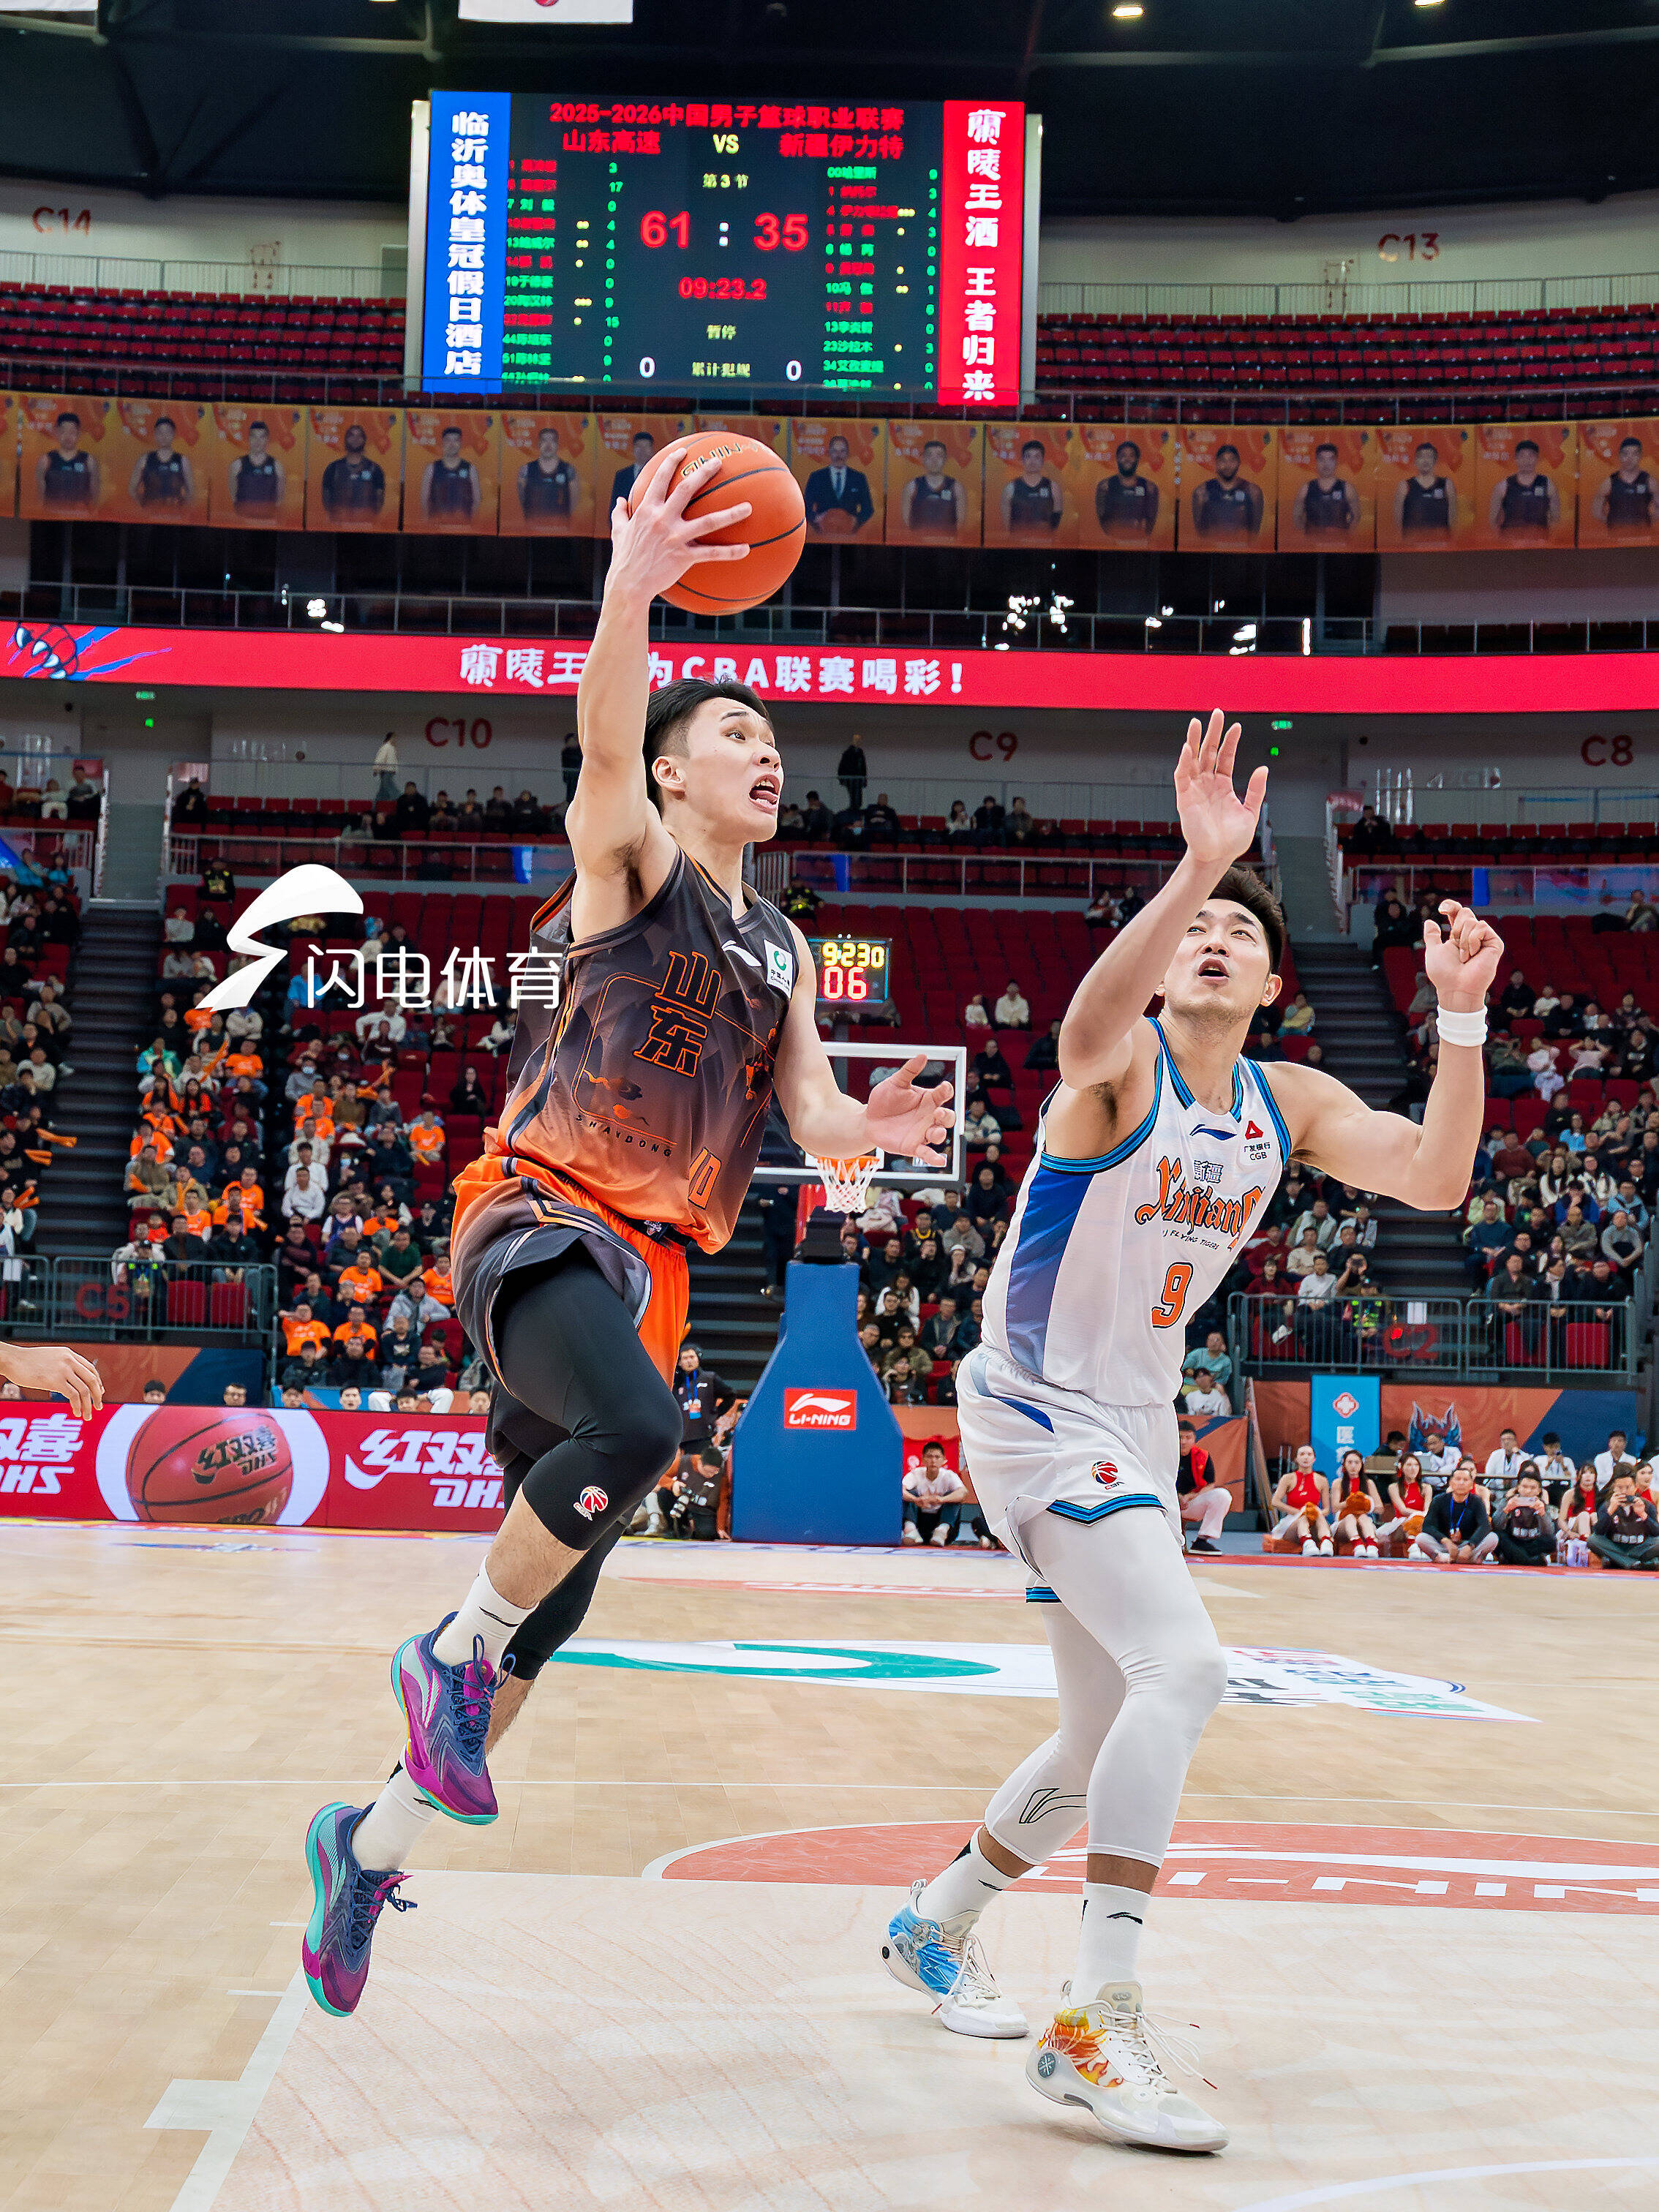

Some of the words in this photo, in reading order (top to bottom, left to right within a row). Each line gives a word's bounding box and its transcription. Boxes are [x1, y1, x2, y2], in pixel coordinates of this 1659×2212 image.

[549, 102, 905, 130] 2025-2026中国男子篮球职业联赛
[562, 129, 661, 155] 山东高速
[712, 134, 740, 154] VS
[780, 133, 904, 159] 新疆伊力特
[609, 162, 618, 174] 3
[609, 181, 624, 193] 17
[721, 174, 731, 189] 3
[607, 200, 617, 212] 0
[32, 208, 92, 238] C14
[640, 210, 691, 249] 61
[753, 211, 810, 252] 35
[443, 111, 490, 376] 临沂奥体皇冠假日酒店
[926, 244, 936, 257] 0
[1378, 233, 1440, 262] C13
[606, 257, 616, 270] 0
[605, 277, 615, 290] 0
[679, 276, 767, 299] 09:23.2
[603, 335, 614, 347] 0
[925, 323, 935, 336] 0
[962, 267, 997, 402] 王者归来
[925, 342, 935, 356] 3
[639, 357, 655, 378] 0
[785, 360, 802, 381] 0
[925, 361, 935, 374] 0
[425, 718, 492, 749] C10
[968, 730, 1017, 761] C9
[1580, 734, 1633, 767] C8
[823, 966, 868, 1000] 06
[633, 950, 722, 1077] 山东
[1249, 1151, 1268, 1161] CGB
[1170, 1230, 1199, 1243] FLYING
[75, 1282, 131, 1320] C5
[1151, 1261, 1193, 1328] 9
[1383, 1321, 1440, 1360] C2
[789, 1413, 851, 1426] LI-NING
[0, 1464, 75, 1494] HS
[429, 1478, 505, 1509] DH
